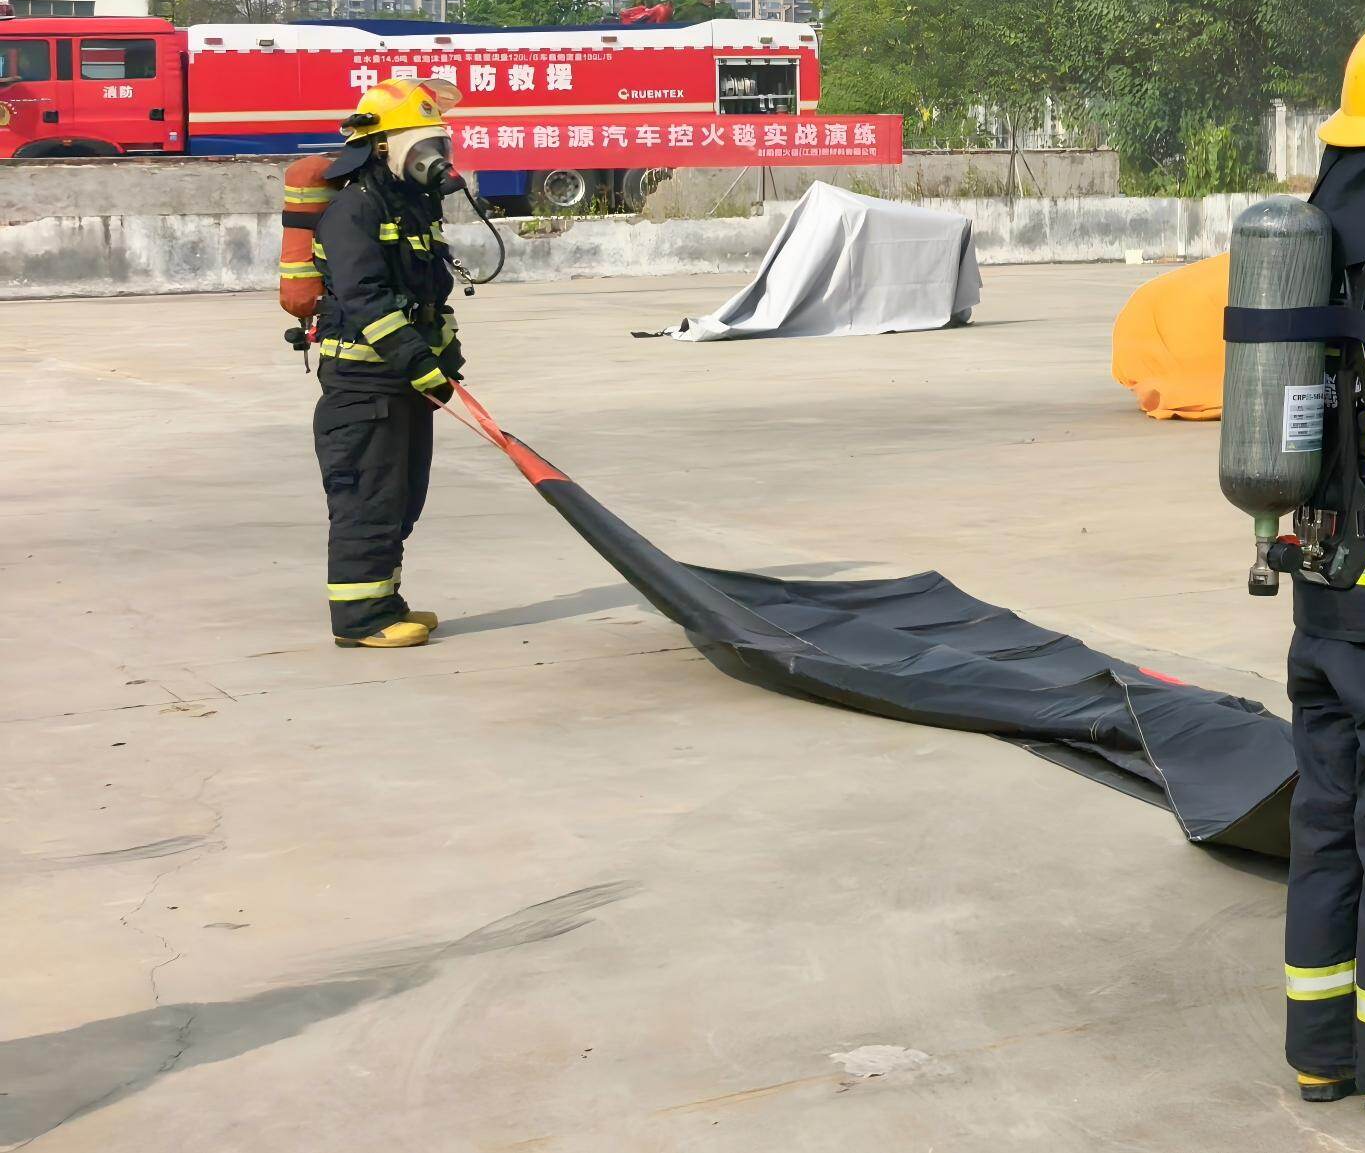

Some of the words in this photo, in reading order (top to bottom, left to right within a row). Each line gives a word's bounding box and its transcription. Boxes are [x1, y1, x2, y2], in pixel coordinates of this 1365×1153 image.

[103, 85, 134, 99] 消防
[631, 89, 684, 99] RUENTEX
[446, 123, 877, 149] 焰新能源汽车控火毯实战演练
